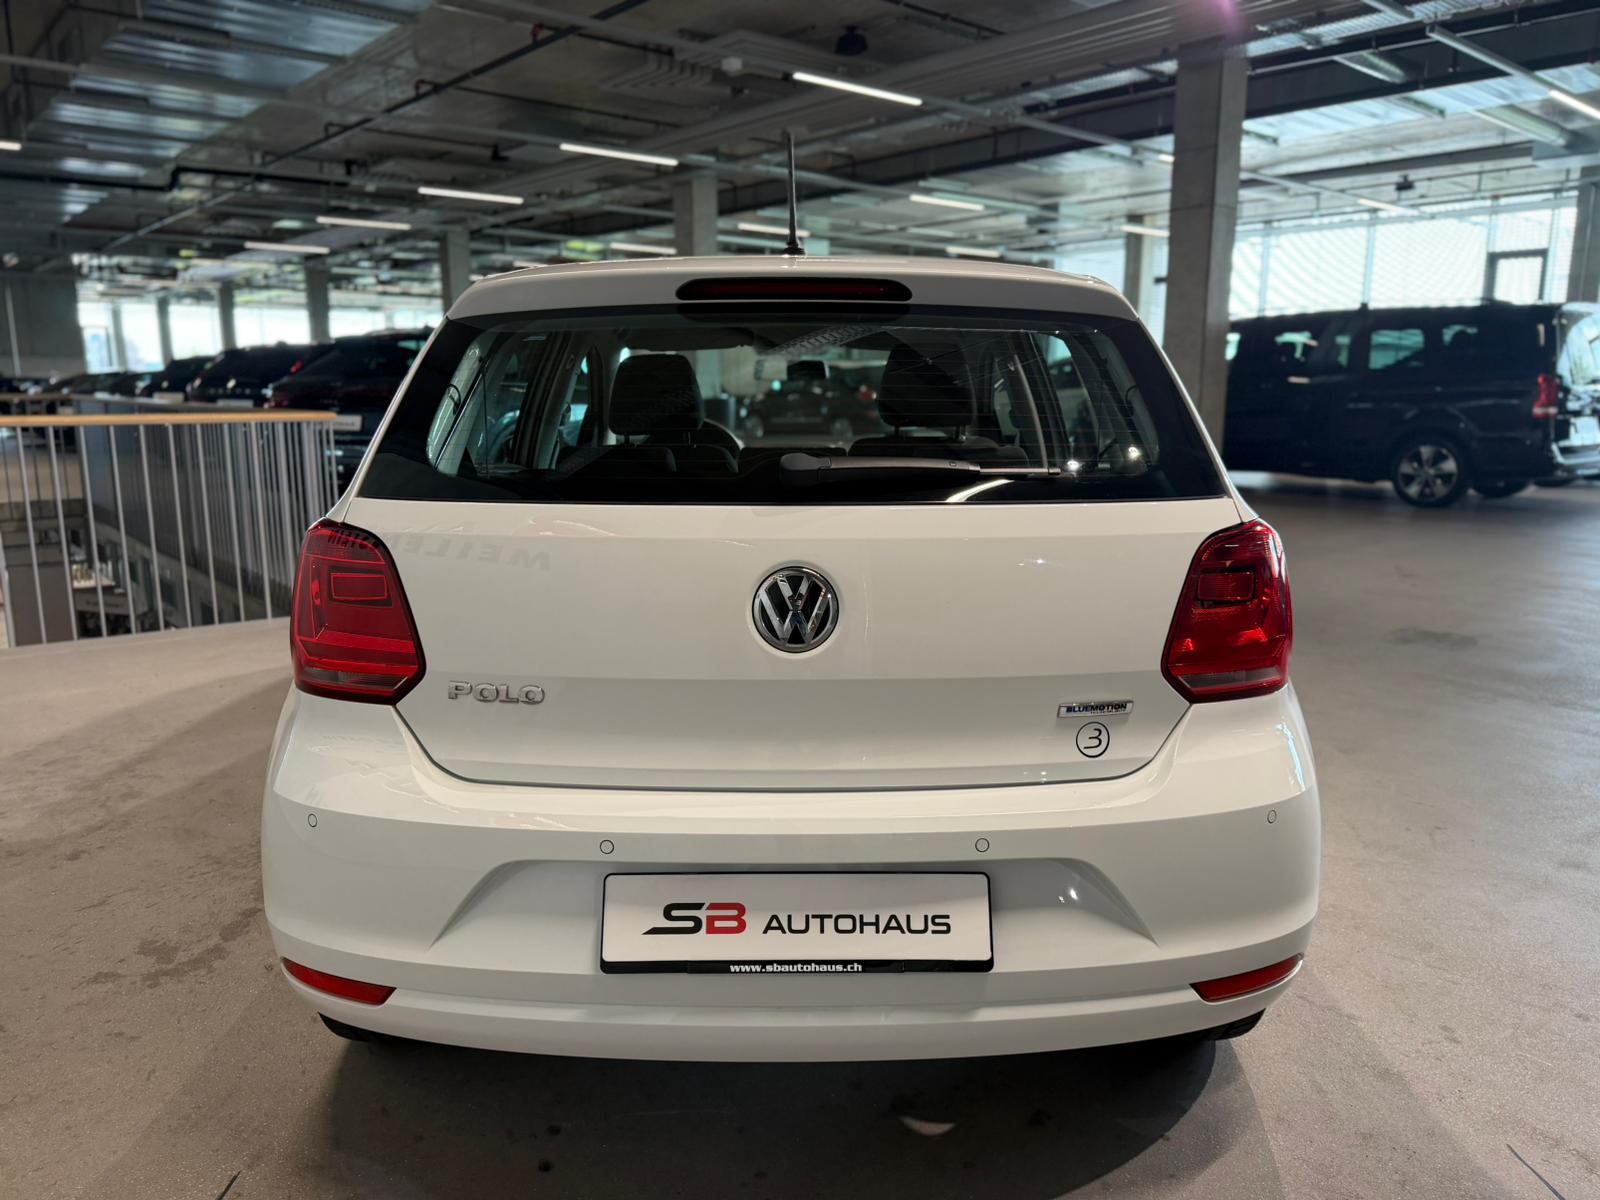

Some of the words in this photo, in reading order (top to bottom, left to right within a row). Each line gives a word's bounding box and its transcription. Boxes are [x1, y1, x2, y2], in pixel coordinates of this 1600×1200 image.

[448, 680, 546, 705] POLO
[1066, 703, 1127, 713] BLUEMOTION
[641, 902, 747, 935] SB
[762, 913, 952, 935] AUTOHAUS
[729, 962, 863, 973] www.sbautohaus.ch
